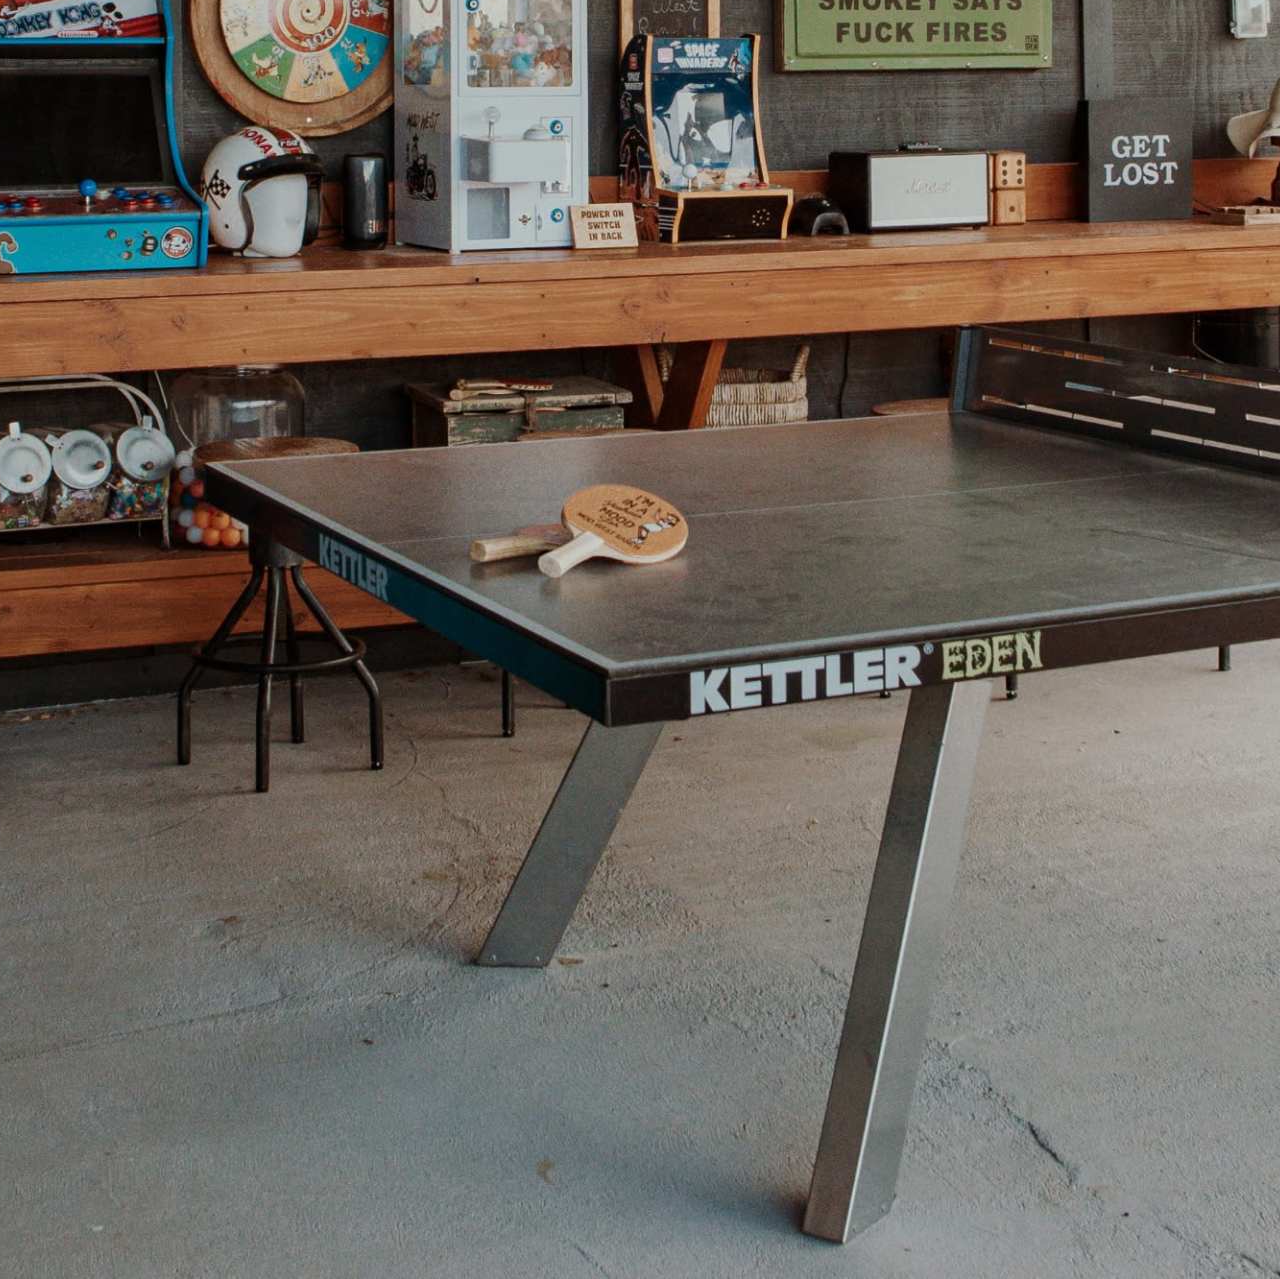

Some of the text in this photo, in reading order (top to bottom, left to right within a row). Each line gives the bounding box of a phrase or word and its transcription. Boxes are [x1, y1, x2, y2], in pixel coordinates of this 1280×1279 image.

[58, 1, 102, 27] KONG
[836, 22, 915, 44] FUCK
[926, 21, 1008, 43] FIRES
[684, 42, 721, 58] SPACE
[674, 57, 729, 70] INVADERS
[1111, 134, 1170, 158] GET
[1103, 161, 1179, 187] LOST
[581, 210, 624, 218] POWER ON
[587, 221, 621, 230] SWITCH
[589, 231, 623, 240] IN BACK
[599, 507, 635, 528] MOOD
[319, 533, 389, 603] KETTLER
[689, 630, 1043, 716] KETTLER EDEN
